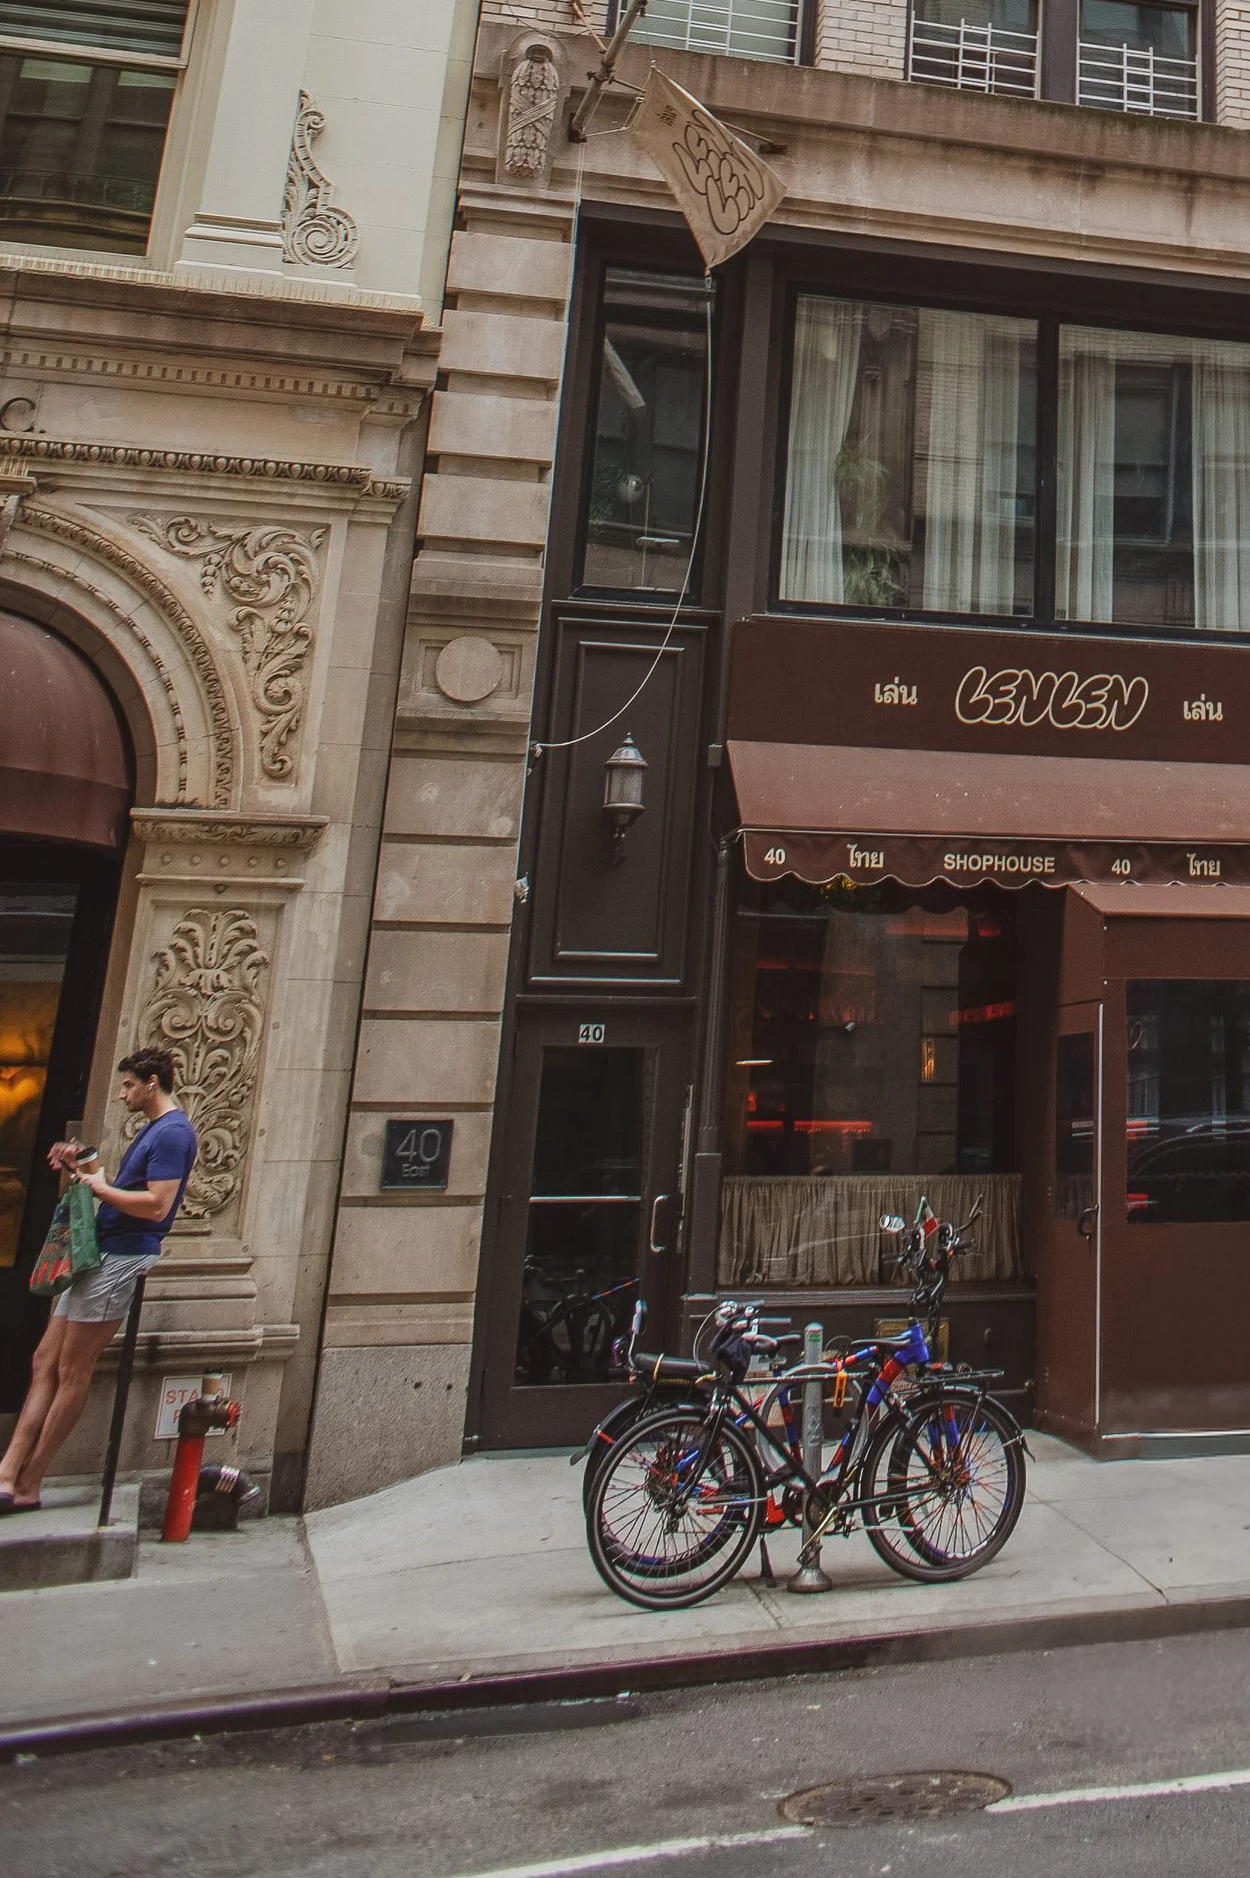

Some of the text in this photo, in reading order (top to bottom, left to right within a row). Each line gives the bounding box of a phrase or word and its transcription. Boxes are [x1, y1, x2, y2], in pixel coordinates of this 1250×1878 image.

[873, 676, 919, 706] เล่น
[1182, 693, 1224, 722] เล่น
[763, 847, 787, 866] 40
[847, 843, 885, 869] ไทย
[943, 853, 1056, 873] SHOPHOUSE
[1111, 858, 1131, 875] 40
[1186, 852, 1221, 877] ไทย
[580, 1025, 603, 1042] 40
[396, 1128, 442, 1162] 40
[402, 1163, 432, 1178] East
